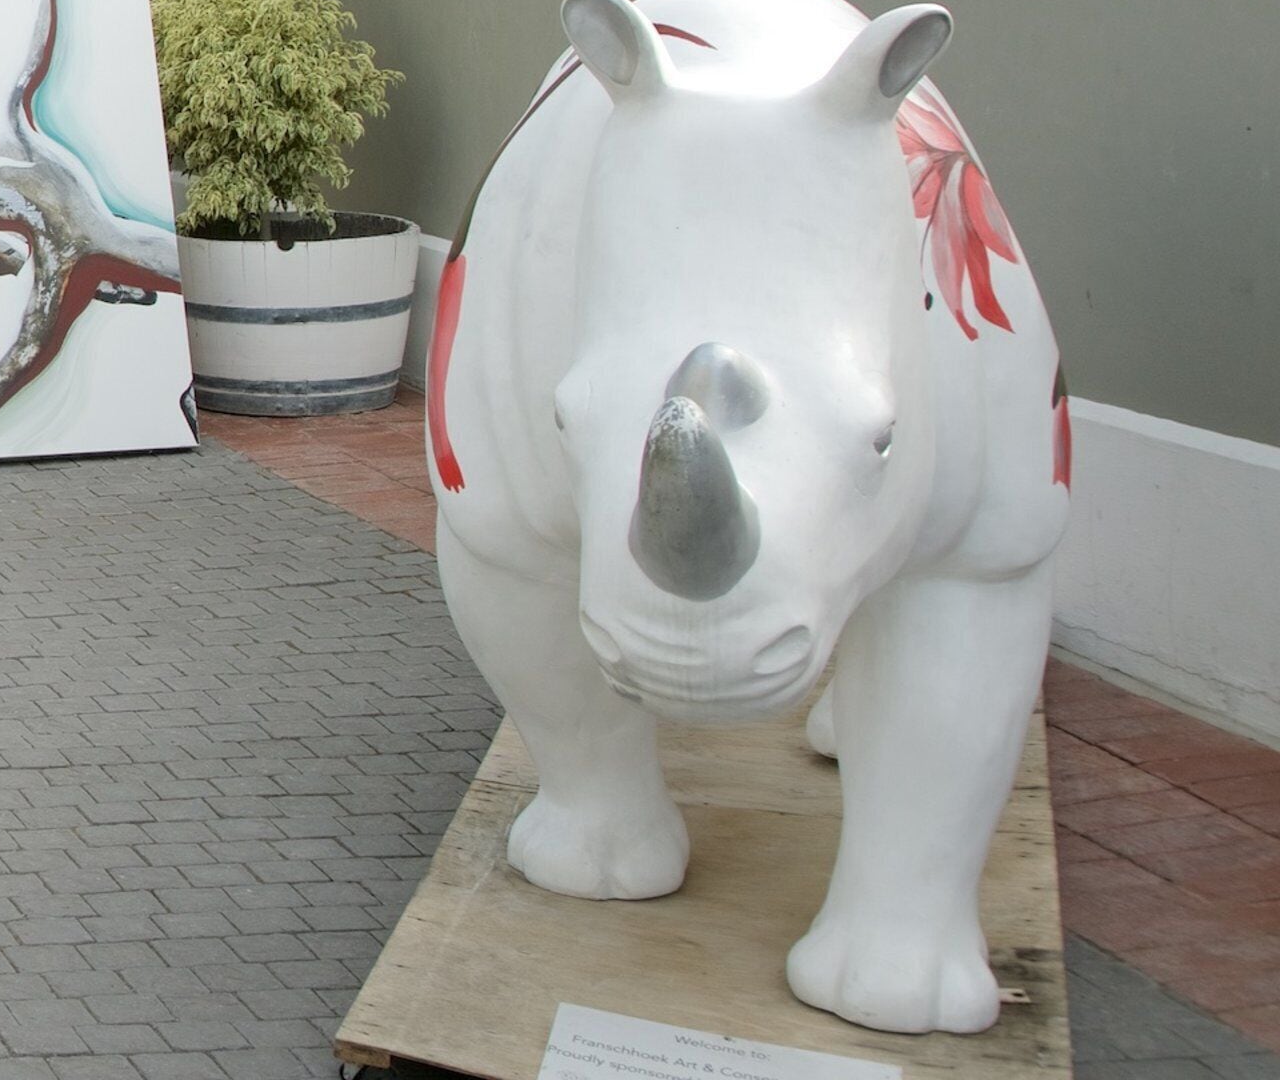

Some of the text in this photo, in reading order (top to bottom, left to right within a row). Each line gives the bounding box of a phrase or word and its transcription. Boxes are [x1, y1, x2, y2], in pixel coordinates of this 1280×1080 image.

[546, 1044, 606, 1068] Proudly
[571, 1034, 669, 1064] Franschhoek
[673, 1057, 697, 1070] Art
[702, 1063, 714, 1074] &
[674, 1034, 746, 1057] Welcome
